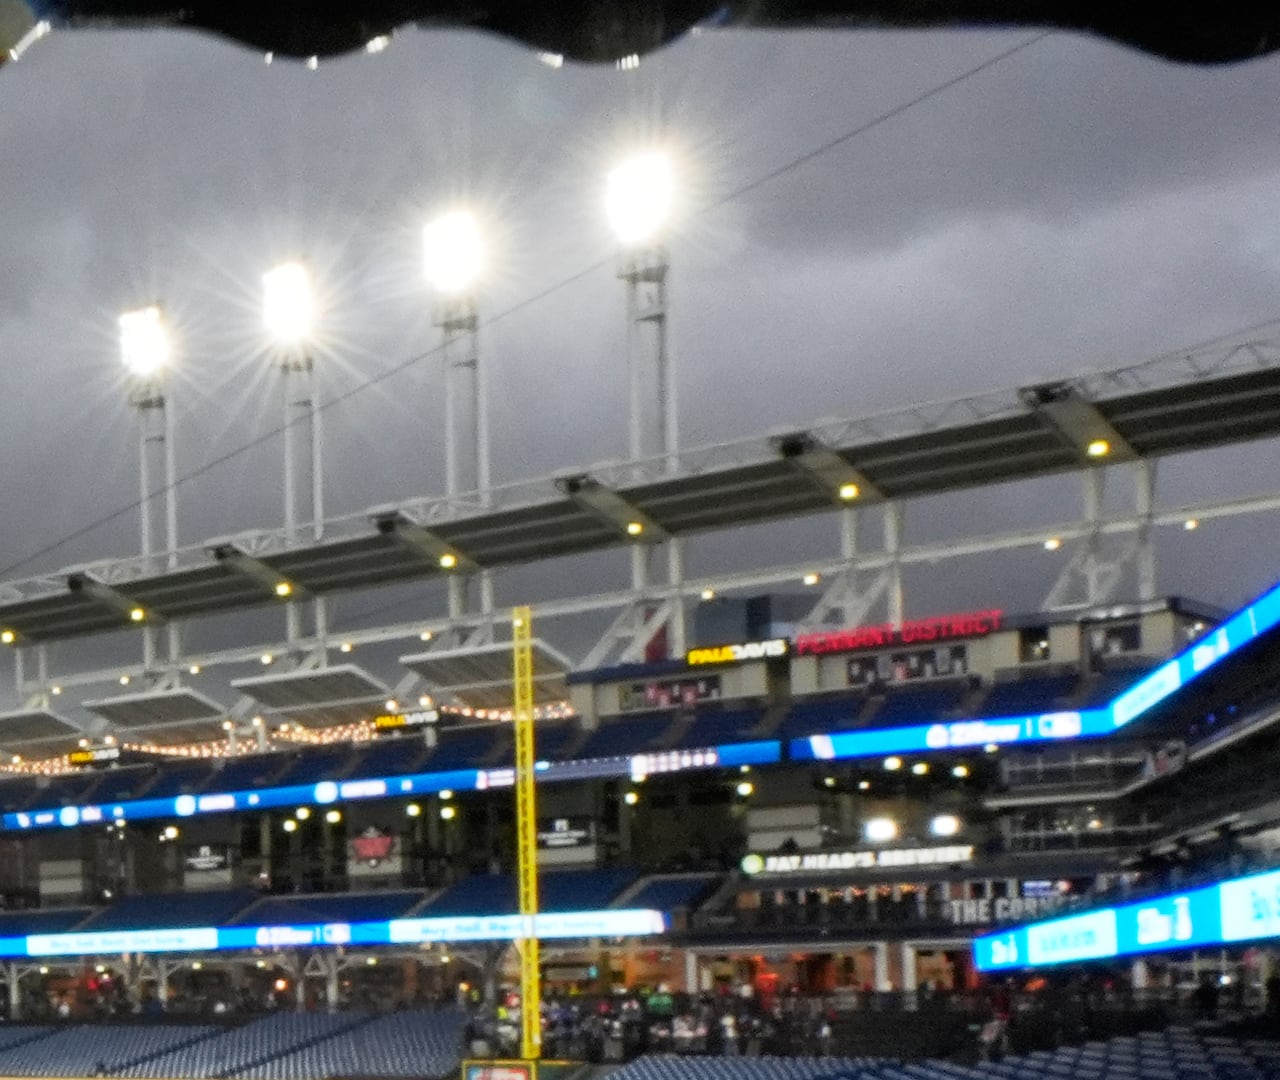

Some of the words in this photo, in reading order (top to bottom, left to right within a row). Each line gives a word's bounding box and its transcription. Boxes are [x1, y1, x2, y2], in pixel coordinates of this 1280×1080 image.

[797, 624, 894, 654] PENNANT
[899, 610, 1003, 643] DISTRICT
[951, 899, 990, 924] THE
